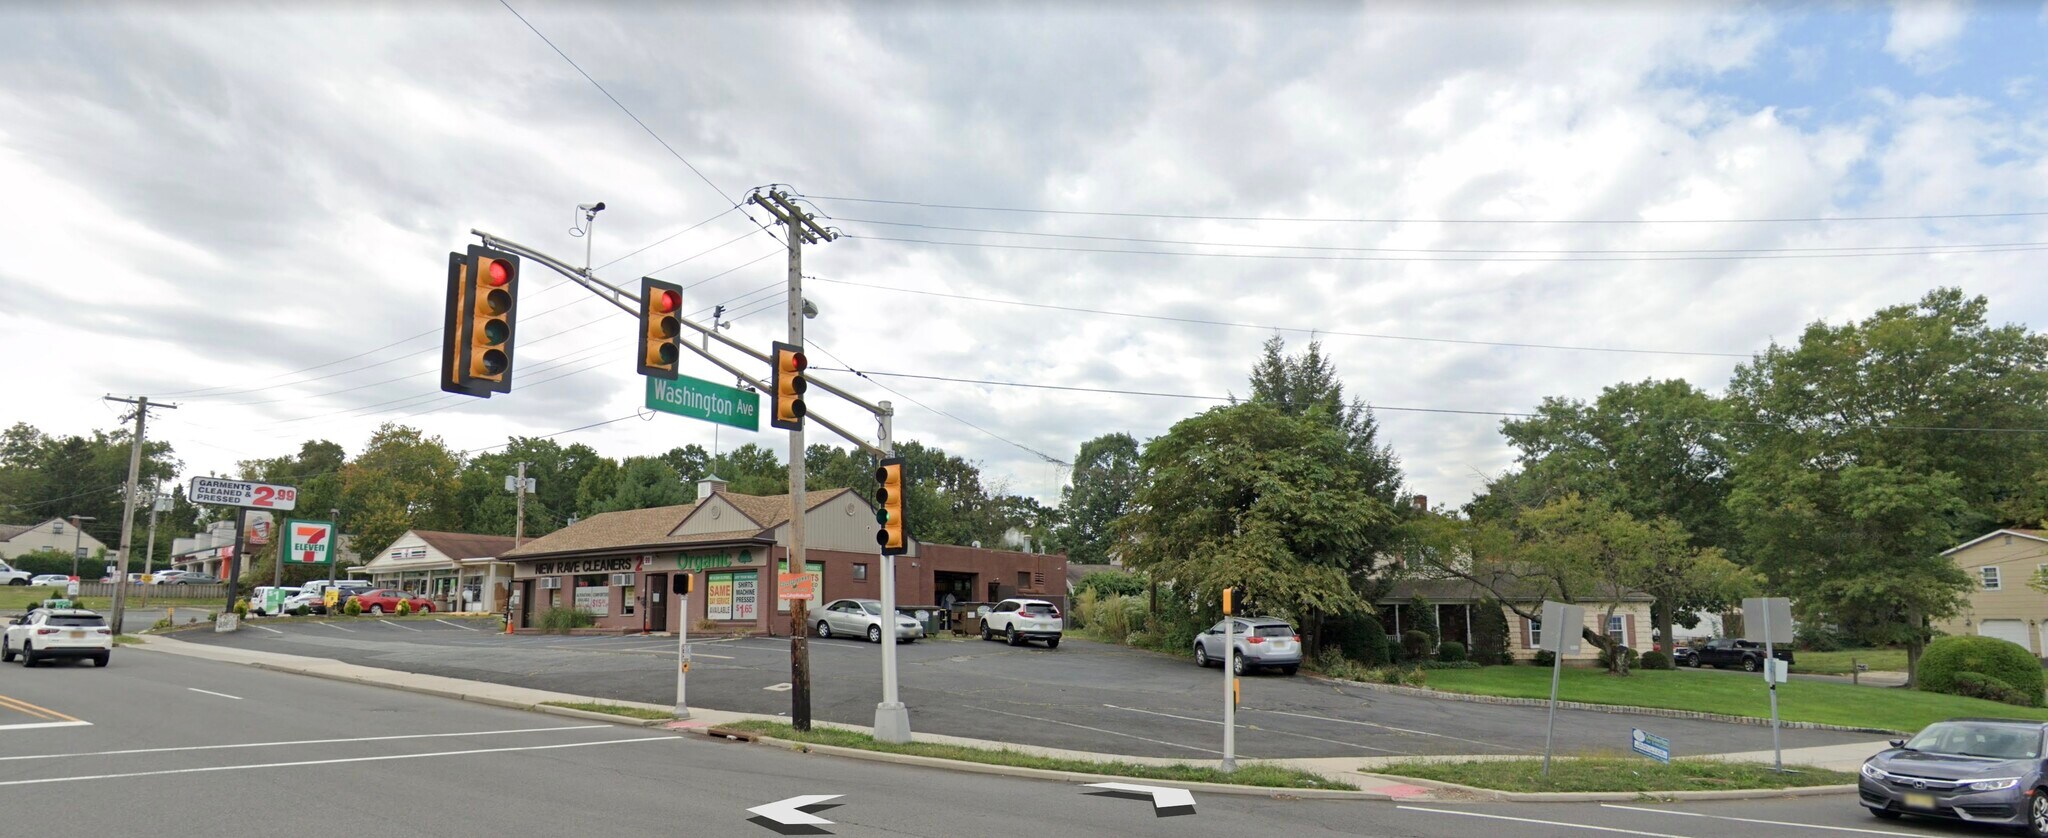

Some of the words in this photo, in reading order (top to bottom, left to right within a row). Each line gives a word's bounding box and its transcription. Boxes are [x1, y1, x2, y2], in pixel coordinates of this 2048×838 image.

[654, 378, 732, 418] Washington
[736, 399, 754, 416] Ave
[199, 479, 252, 491] GARMENTS
[198, 486, 242, 497] CLEANED
[196, 493, 240, 504] PRESSED
[297, 526, 326, 562] 7
[535, 563, 555, 574] NEW
[557, 560, 580, 573] RAVE
[583, 559, 631, 572] CLEANERS
[635, 555, 643, 572] 2
[677, 551, 732, 573] Organic
[710, 585, 730, 597] SAME
[716, 597, 730, 605] SERVICE
[710, 606, 730, 614] AVAILABLE
